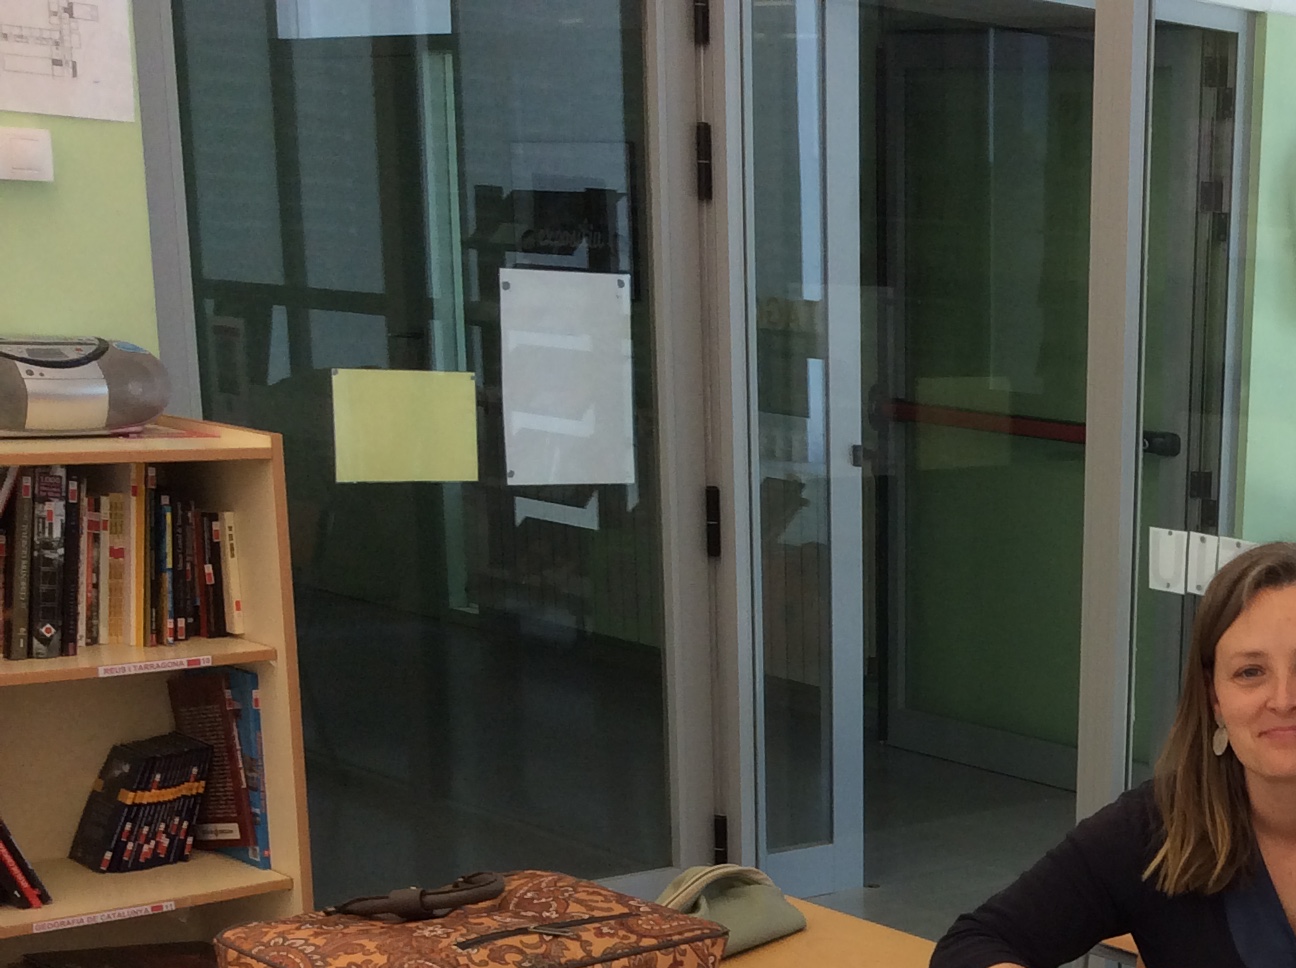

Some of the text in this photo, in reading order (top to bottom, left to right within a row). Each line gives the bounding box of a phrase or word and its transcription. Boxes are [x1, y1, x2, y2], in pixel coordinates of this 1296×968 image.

[133, 660, 185, 671] TARRAGONA
[34, 917, 85, 932] GEOGRAFIA
[100, 907, 150, 923] CATALUNYA
